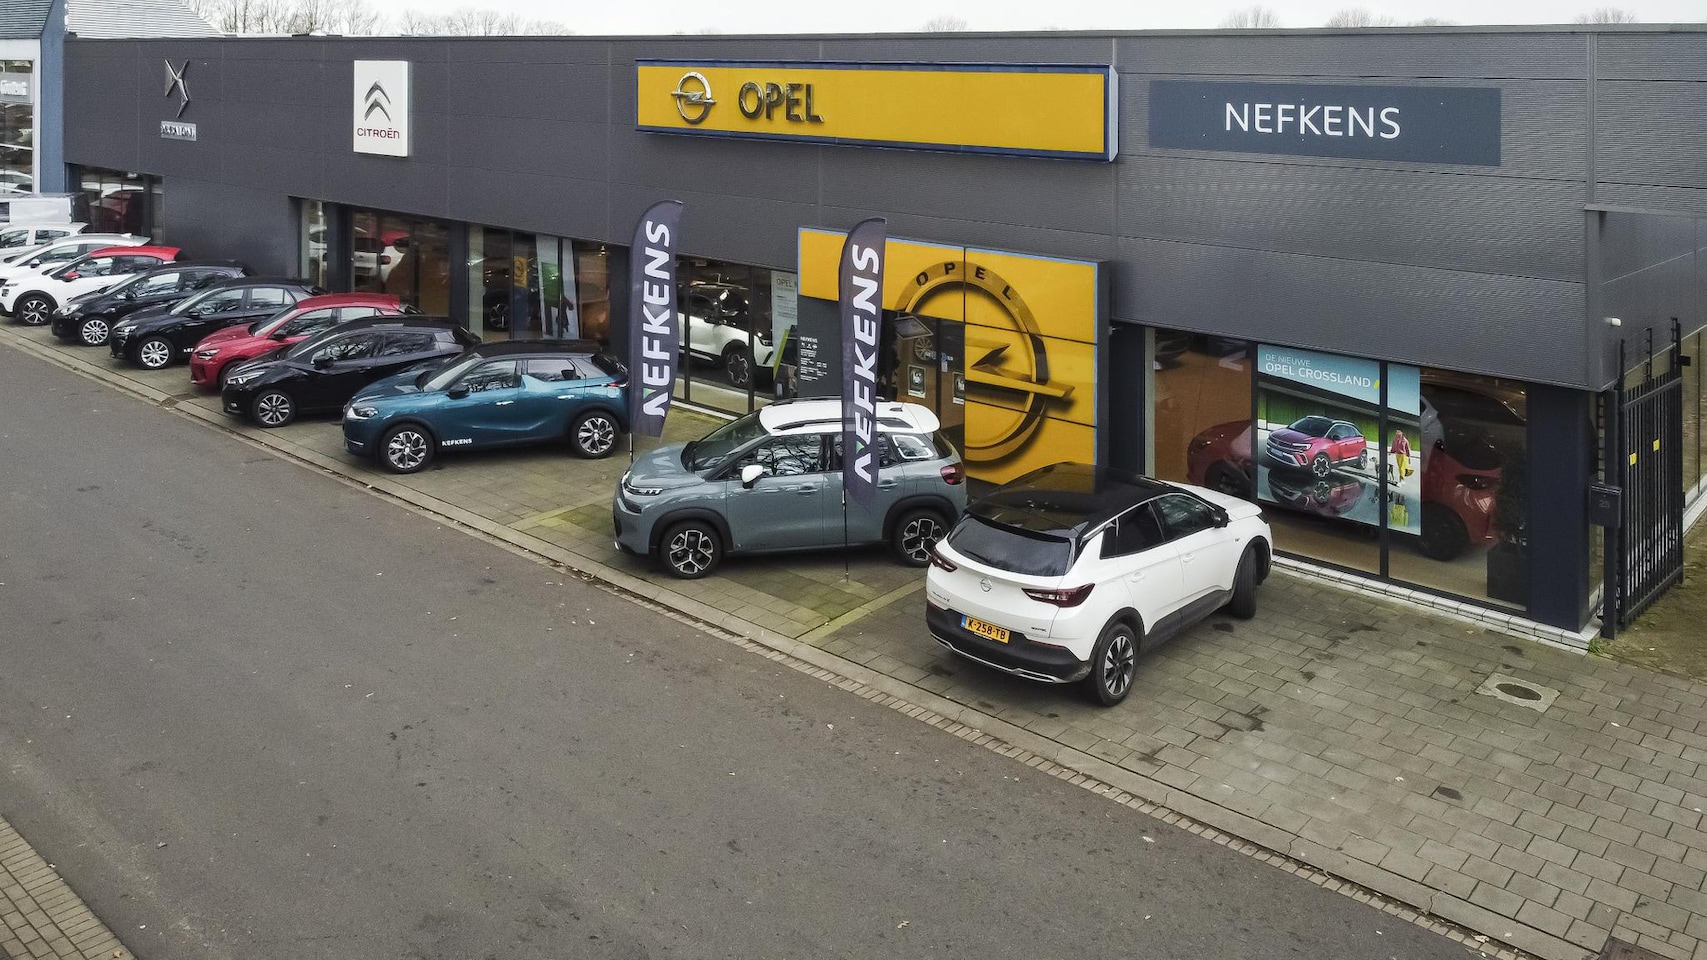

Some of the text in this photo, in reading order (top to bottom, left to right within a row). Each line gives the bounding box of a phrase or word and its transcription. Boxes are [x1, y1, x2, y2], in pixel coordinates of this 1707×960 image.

[738, 81, 824, 123] OPEL
[1225, 102, 1401, 139] NEFKENS
[916, 262, 1012, 301] OPEL
[642, 220, 671, 417] NEFKENS
[851, 244, 880, 484] NEFKENS
[1265, 353, 1311, 367] DE NIEUWE
[1265, 362, 1371, 388] OPEL CROSSLAND
[441, 438, 472, 447] NEFKENS
[968, 618, 1006, 640] K-258-TB
